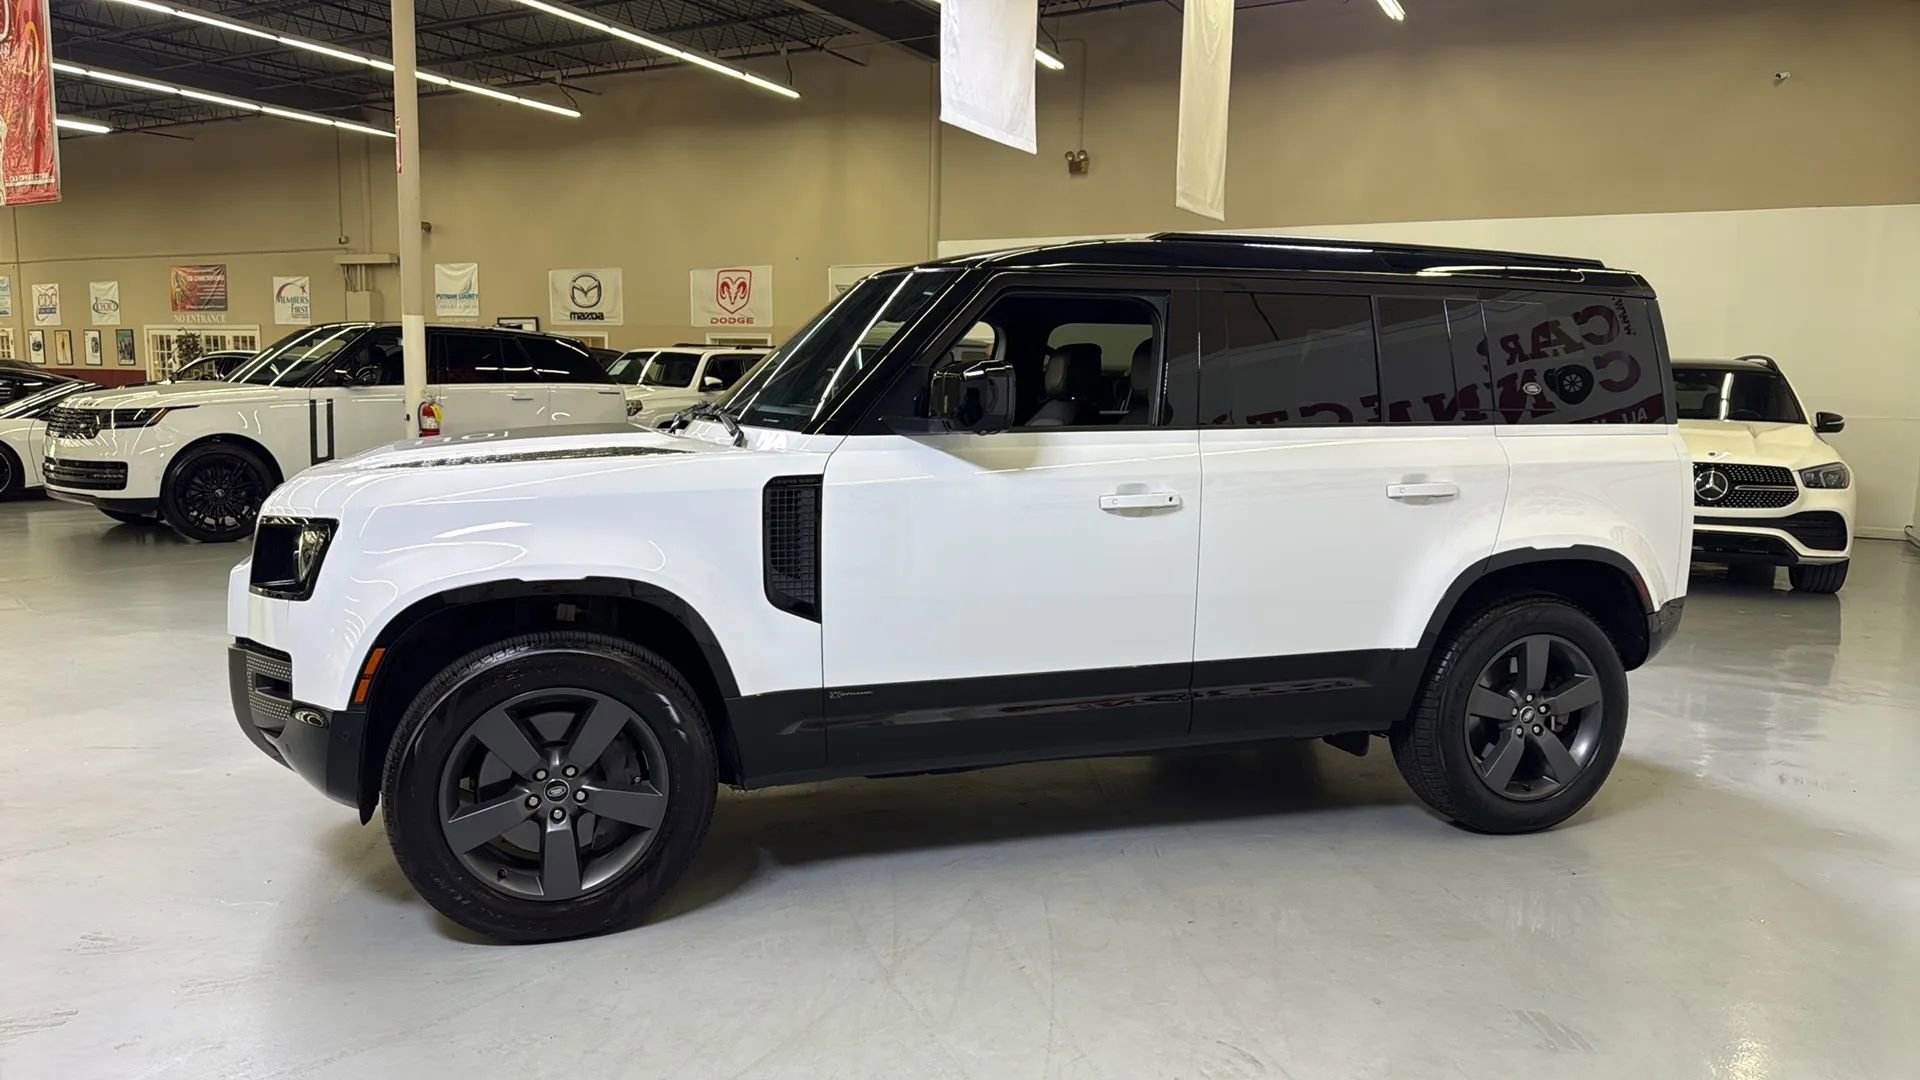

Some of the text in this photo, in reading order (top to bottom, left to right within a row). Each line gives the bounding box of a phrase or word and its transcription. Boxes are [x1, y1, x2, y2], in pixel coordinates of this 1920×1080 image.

[276, 296, 309, 304] MEMBERS
[291, 304, 309, 313] FIRST
[174, 314, 226, 323] NO ENTRANCE
[710, 316, 755, 324] DODGE
